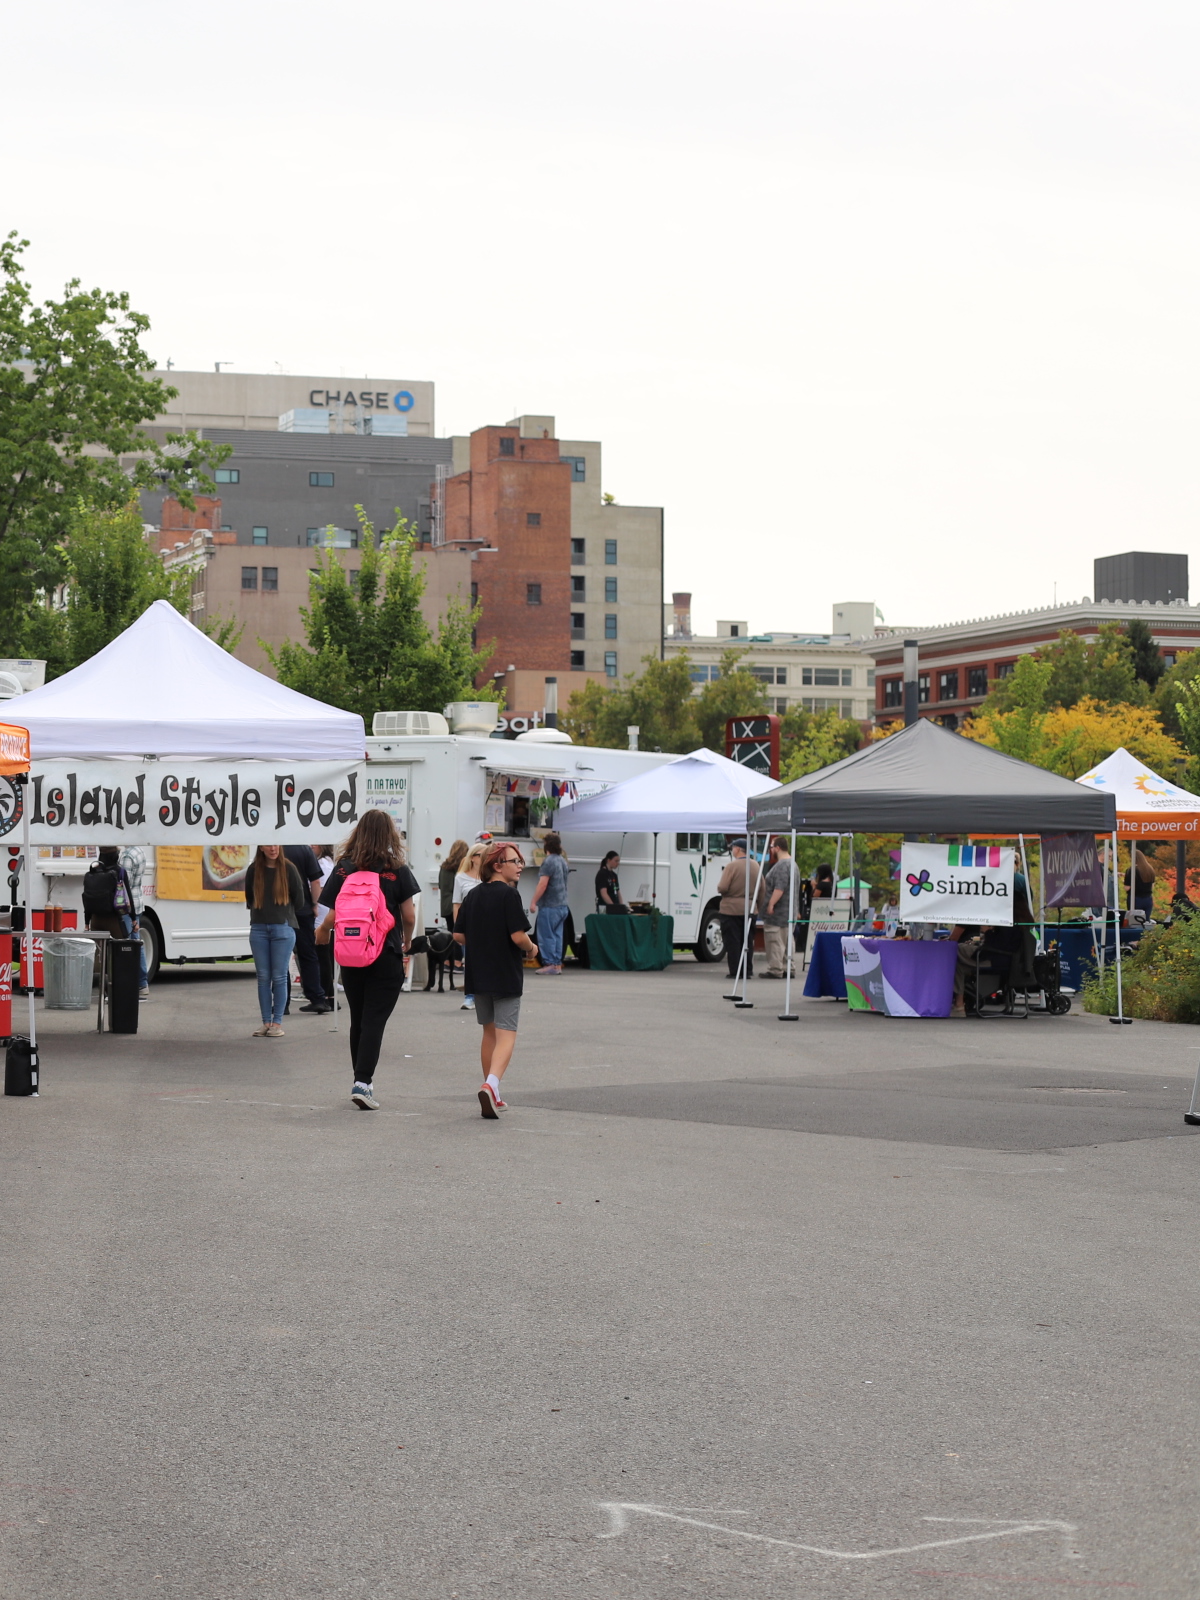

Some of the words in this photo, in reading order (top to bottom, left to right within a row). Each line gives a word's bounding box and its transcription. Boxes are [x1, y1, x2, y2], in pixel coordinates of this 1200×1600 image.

[310, 390, 389, 409] CHASE
[30, 773, 146, 829] Island
[159, 774, 261, 836] Style
[274, 772, 358, 829] Food
[1116, 819, 1138, 831] The
[1141, 822, 1182, 834] power
[1185, 818, 1199, 831] of
[936, 875, 1008, 897] simba
